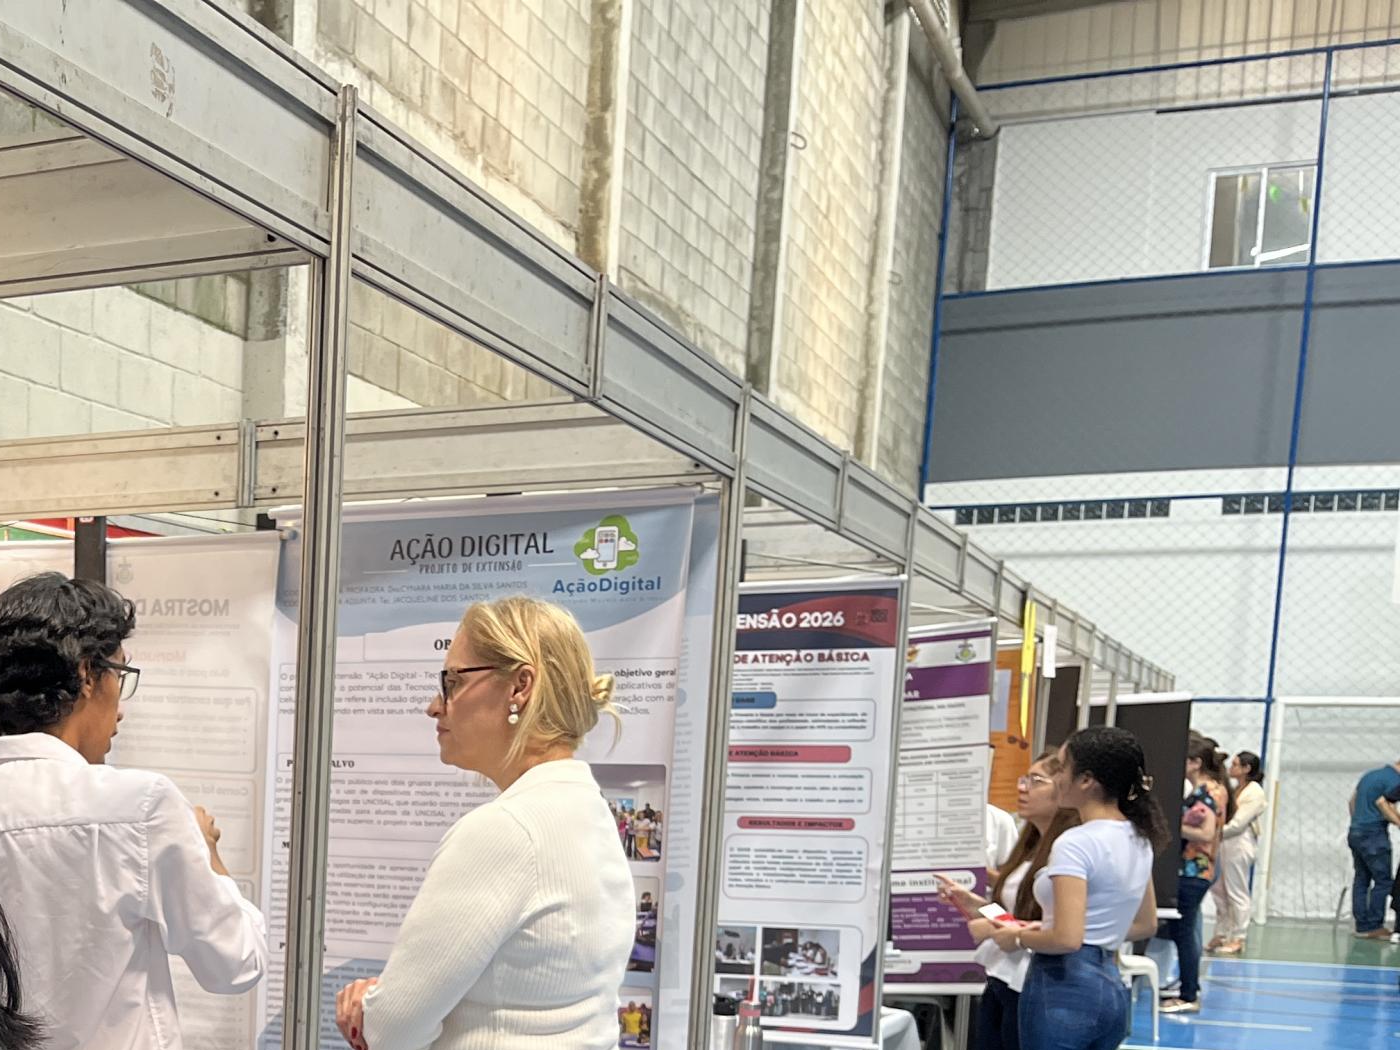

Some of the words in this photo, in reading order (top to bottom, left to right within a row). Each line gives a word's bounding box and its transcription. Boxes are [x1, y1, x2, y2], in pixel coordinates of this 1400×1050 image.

[390, 535, 453, 565] AÇÃO
[460, 531, 556, 558] DIGITAL
[418, 562, 458, 574] PROJETO
[461, 561, 474, 573] DE
[476, 560, 523, 573] EXTENSÃO
[552, 573, 662, 598] AçãoDigital
[736, 609, 798, 630] ENSÃO
[798, 611, 846, 629] 2026
[751, 649, 814, 666] ATENÇÃO
[817, 650, 871, 664] BÁSICA
[614, 667, 653, 679] objetivo
[654, 667, 677, 680] geral
